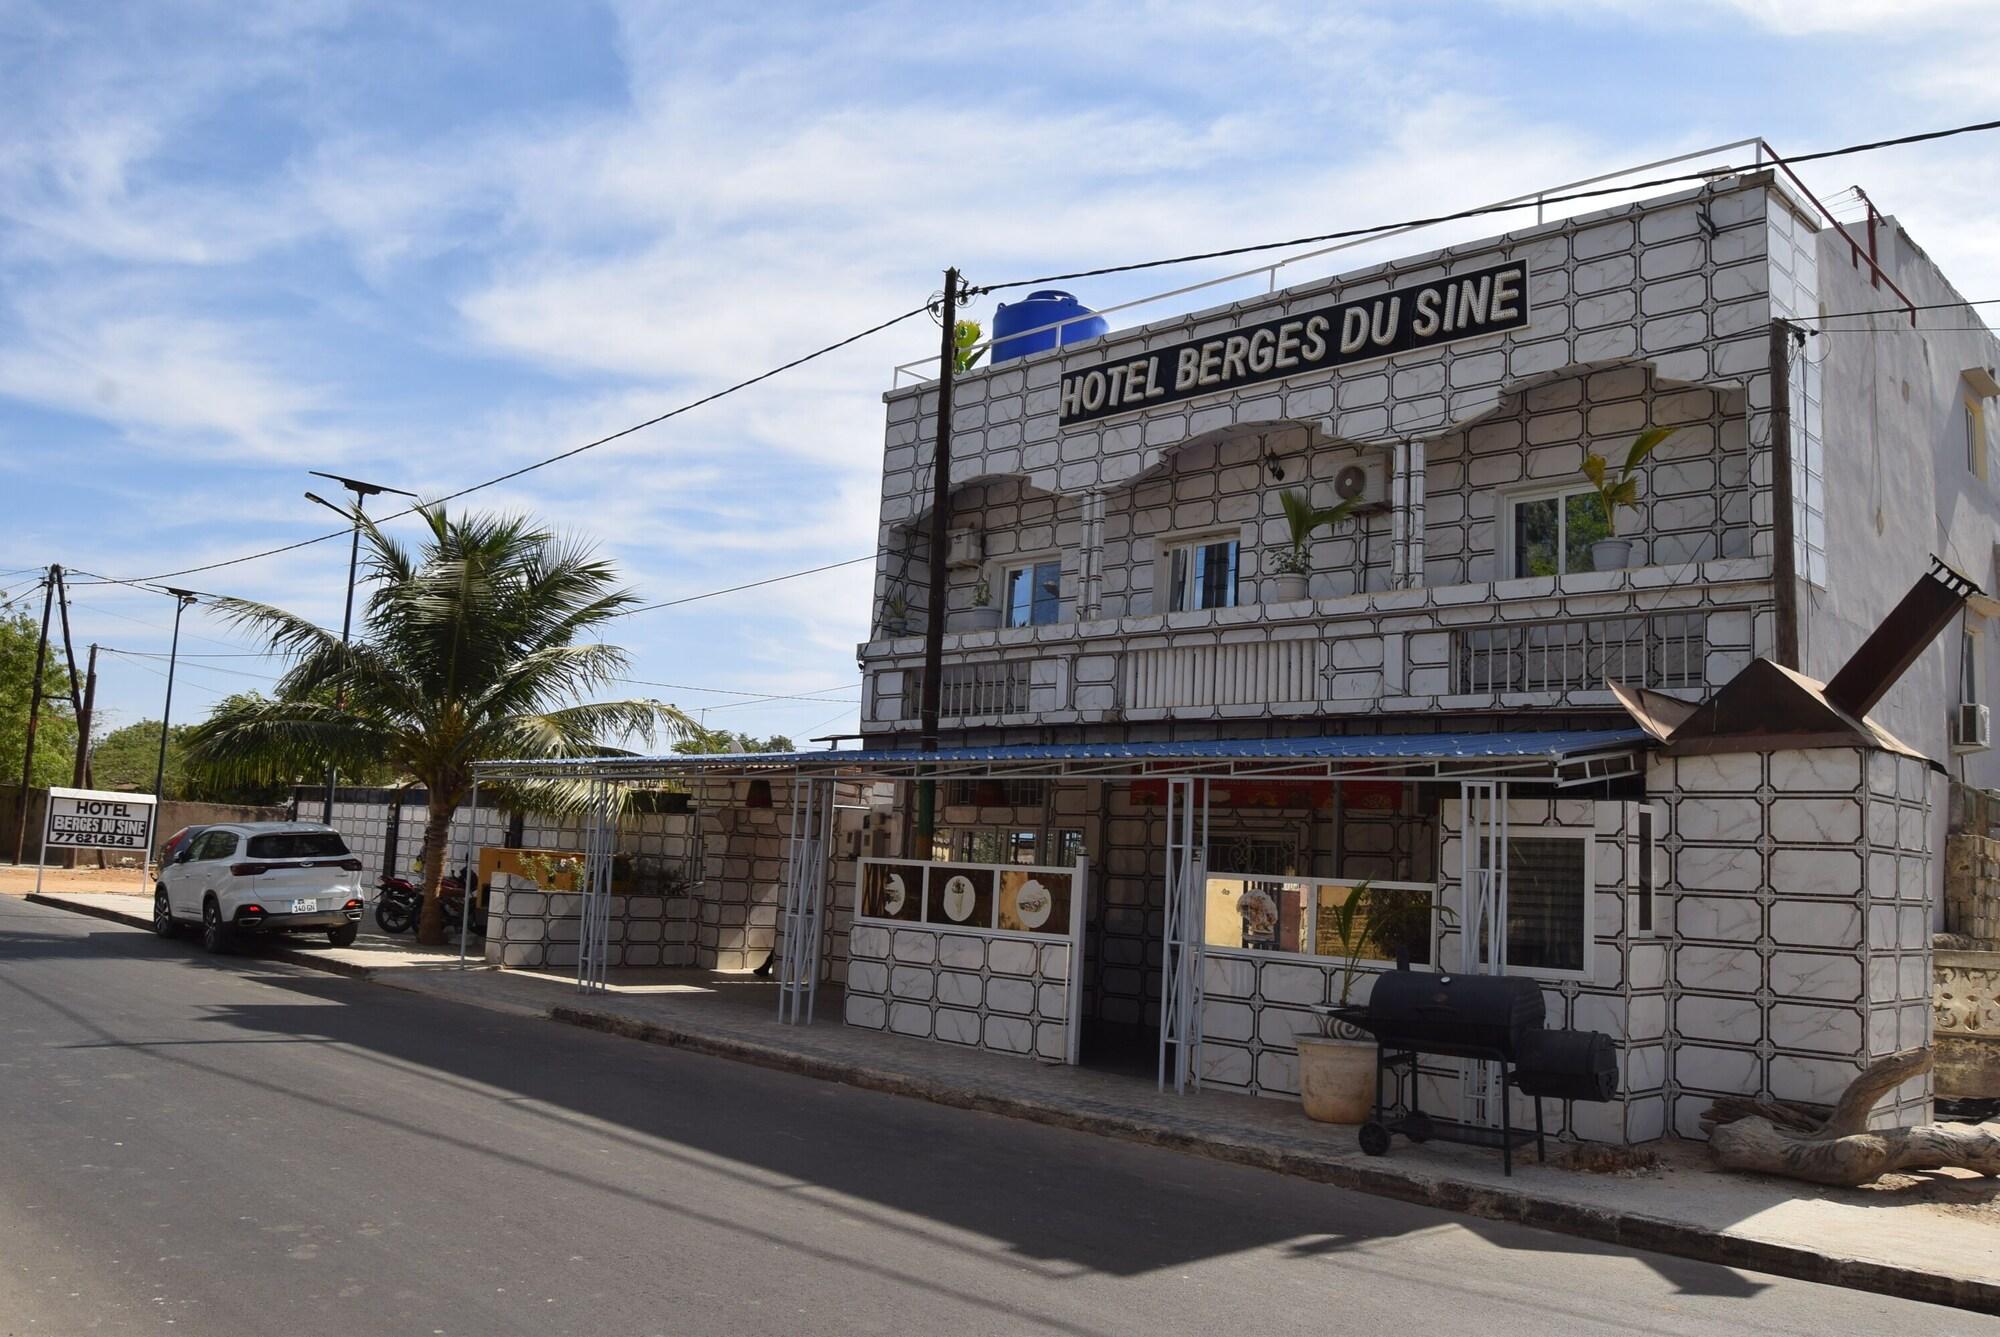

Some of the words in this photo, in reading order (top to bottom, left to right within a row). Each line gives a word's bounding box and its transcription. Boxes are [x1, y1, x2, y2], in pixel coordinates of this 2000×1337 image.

[1060, 355, 1165, 419] HOTEL
[1175, 314, 1330, 392] BERGES
[1340, 296, 1401, 354] DU
[1413, 268, 1522, 338] SINE
[76, 801, 131, 817] HOTEL
[54, 815, 100, 832] BERGES
[101, 819, 115, 834] DU
[116, 821, 145, 836] SINE
